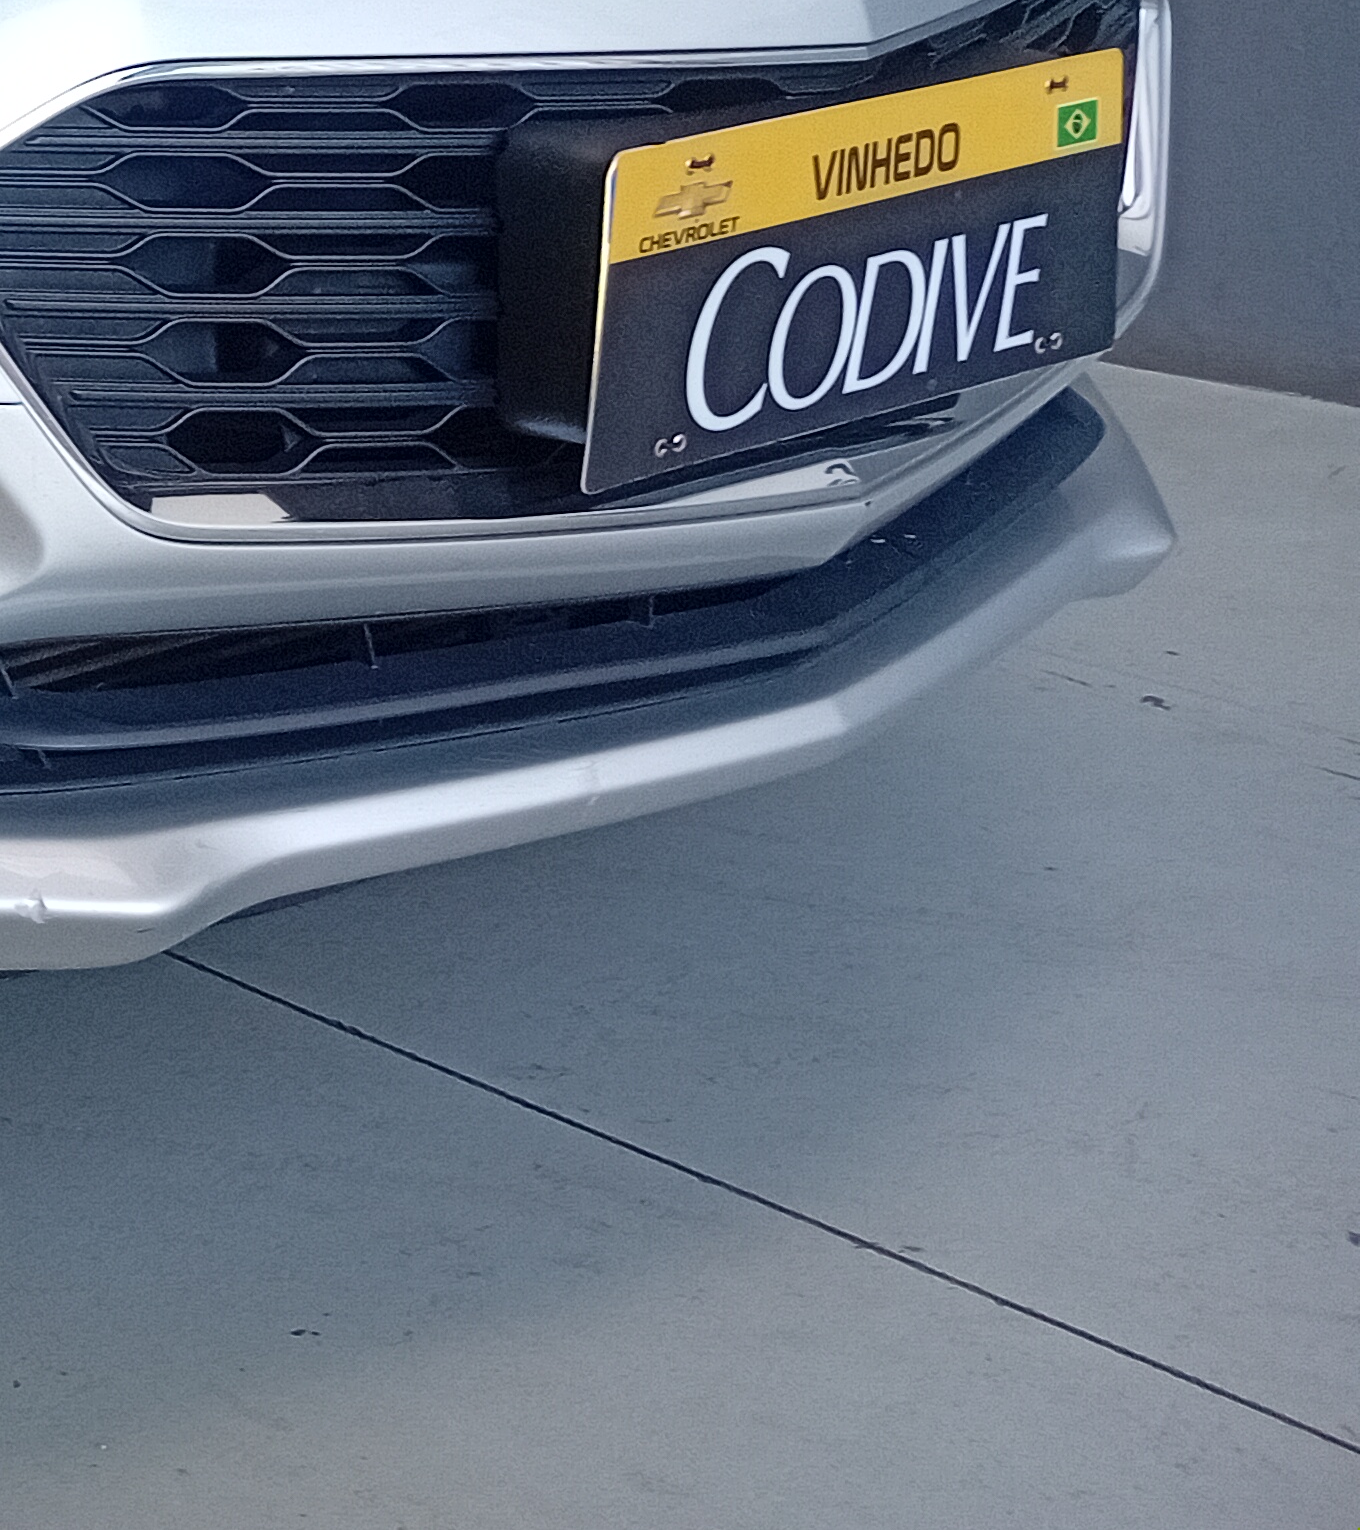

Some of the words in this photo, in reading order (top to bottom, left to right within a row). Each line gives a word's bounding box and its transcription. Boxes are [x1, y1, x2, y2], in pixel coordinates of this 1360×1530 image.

[811, 122, 961, 201] VINHEDO
[639, 215, 741, 253] CHEVROLET
[685, 213, 1048, 432] CODIVE
